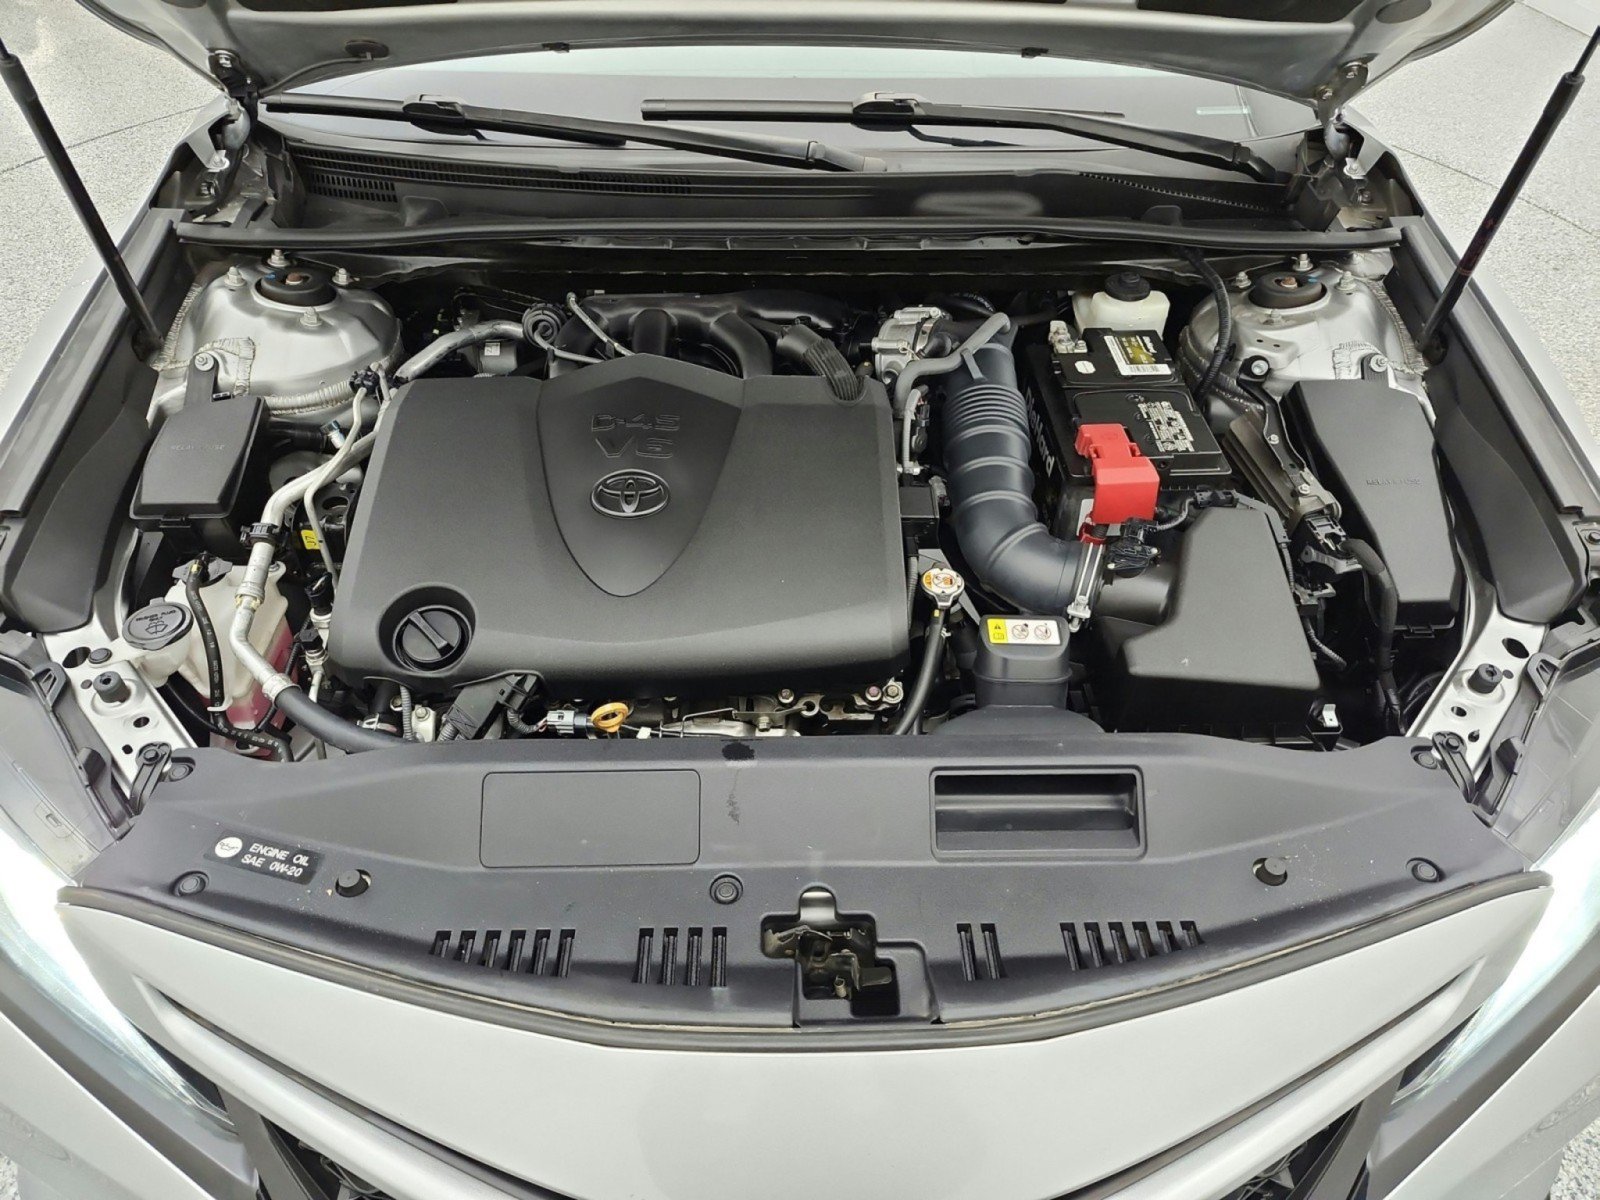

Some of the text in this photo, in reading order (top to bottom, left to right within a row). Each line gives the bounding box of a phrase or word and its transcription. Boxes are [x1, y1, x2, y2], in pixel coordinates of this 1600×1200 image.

[595, 436, 674, 459] V6
[241, 854, 304, 877] SAE 0W-20
[249, 843, 310, 867] ENGINE OIL
